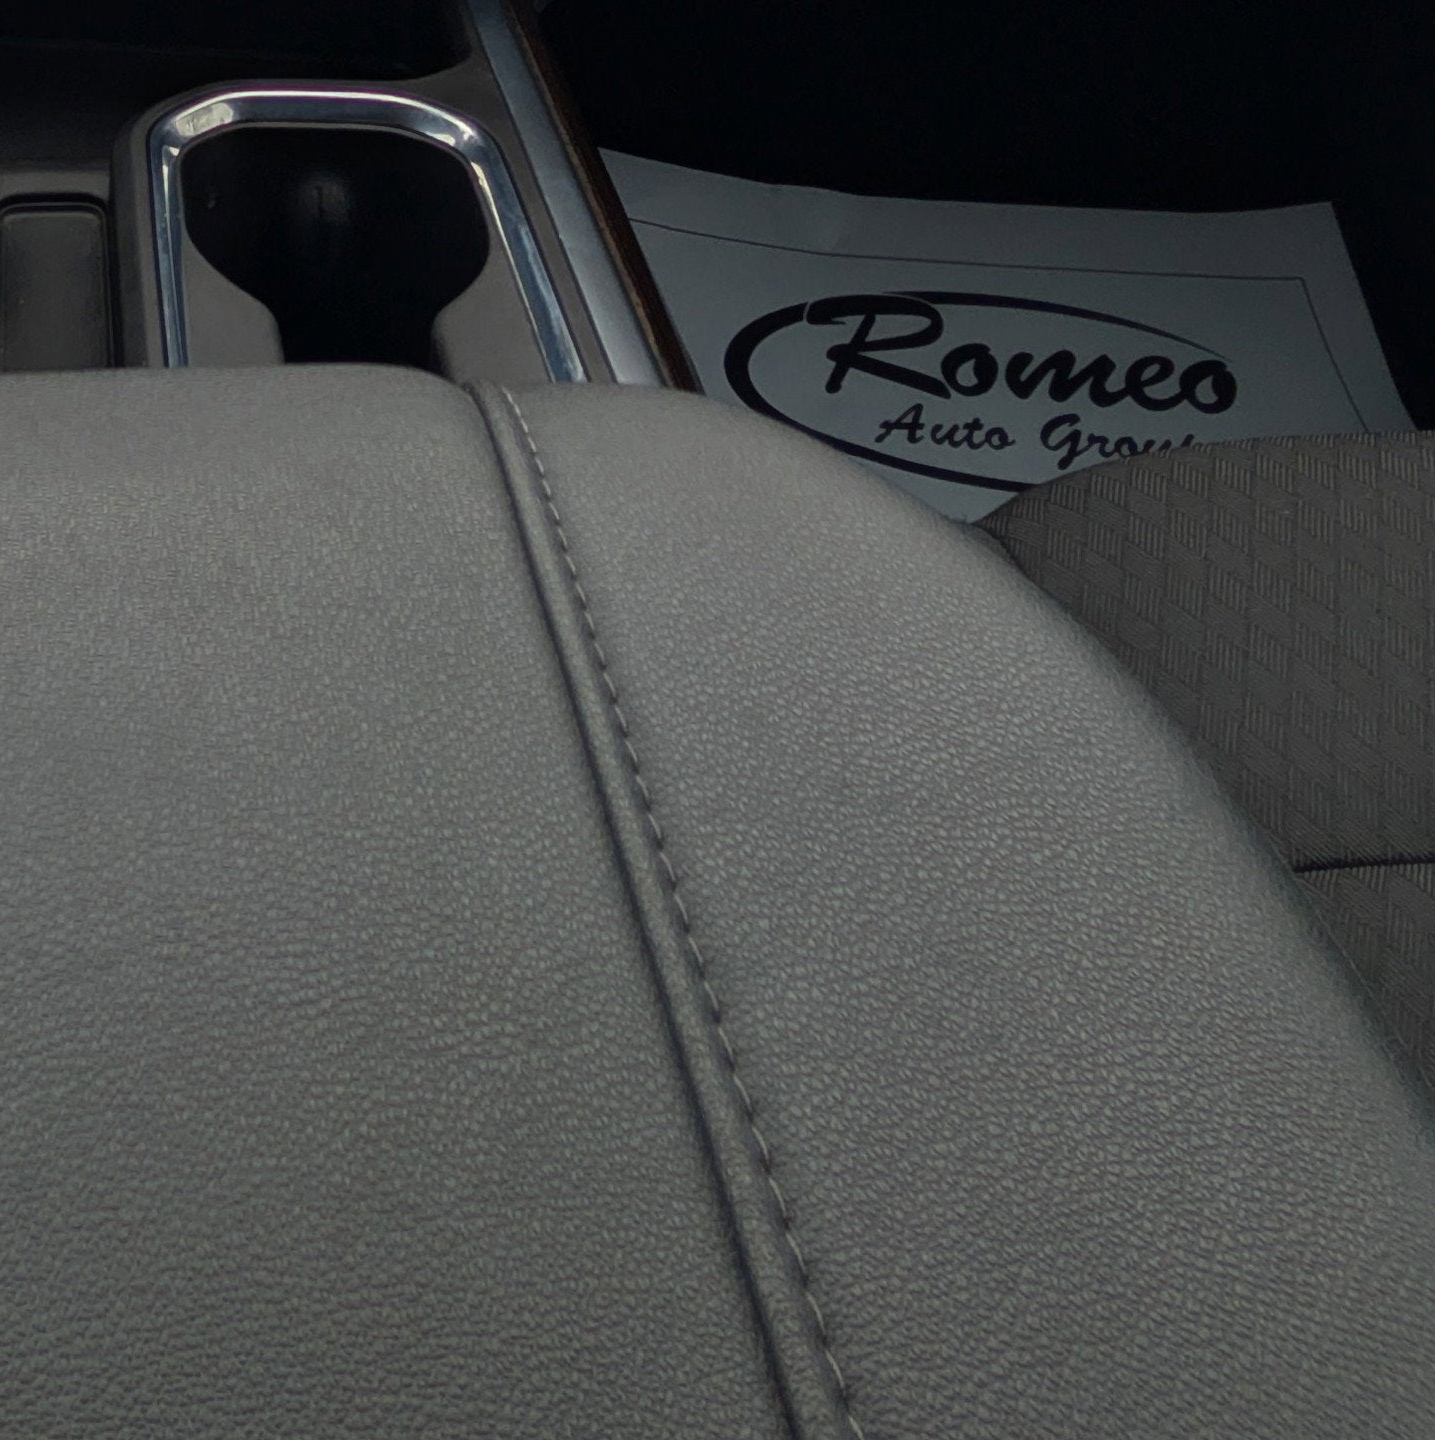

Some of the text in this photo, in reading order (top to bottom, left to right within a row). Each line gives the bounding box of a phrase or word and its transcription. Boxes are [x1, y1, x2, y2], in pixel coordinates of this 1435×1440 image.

[804, 294, 1238, 415] Romeo
[876, 403, 1195, 471] Auto Grou
